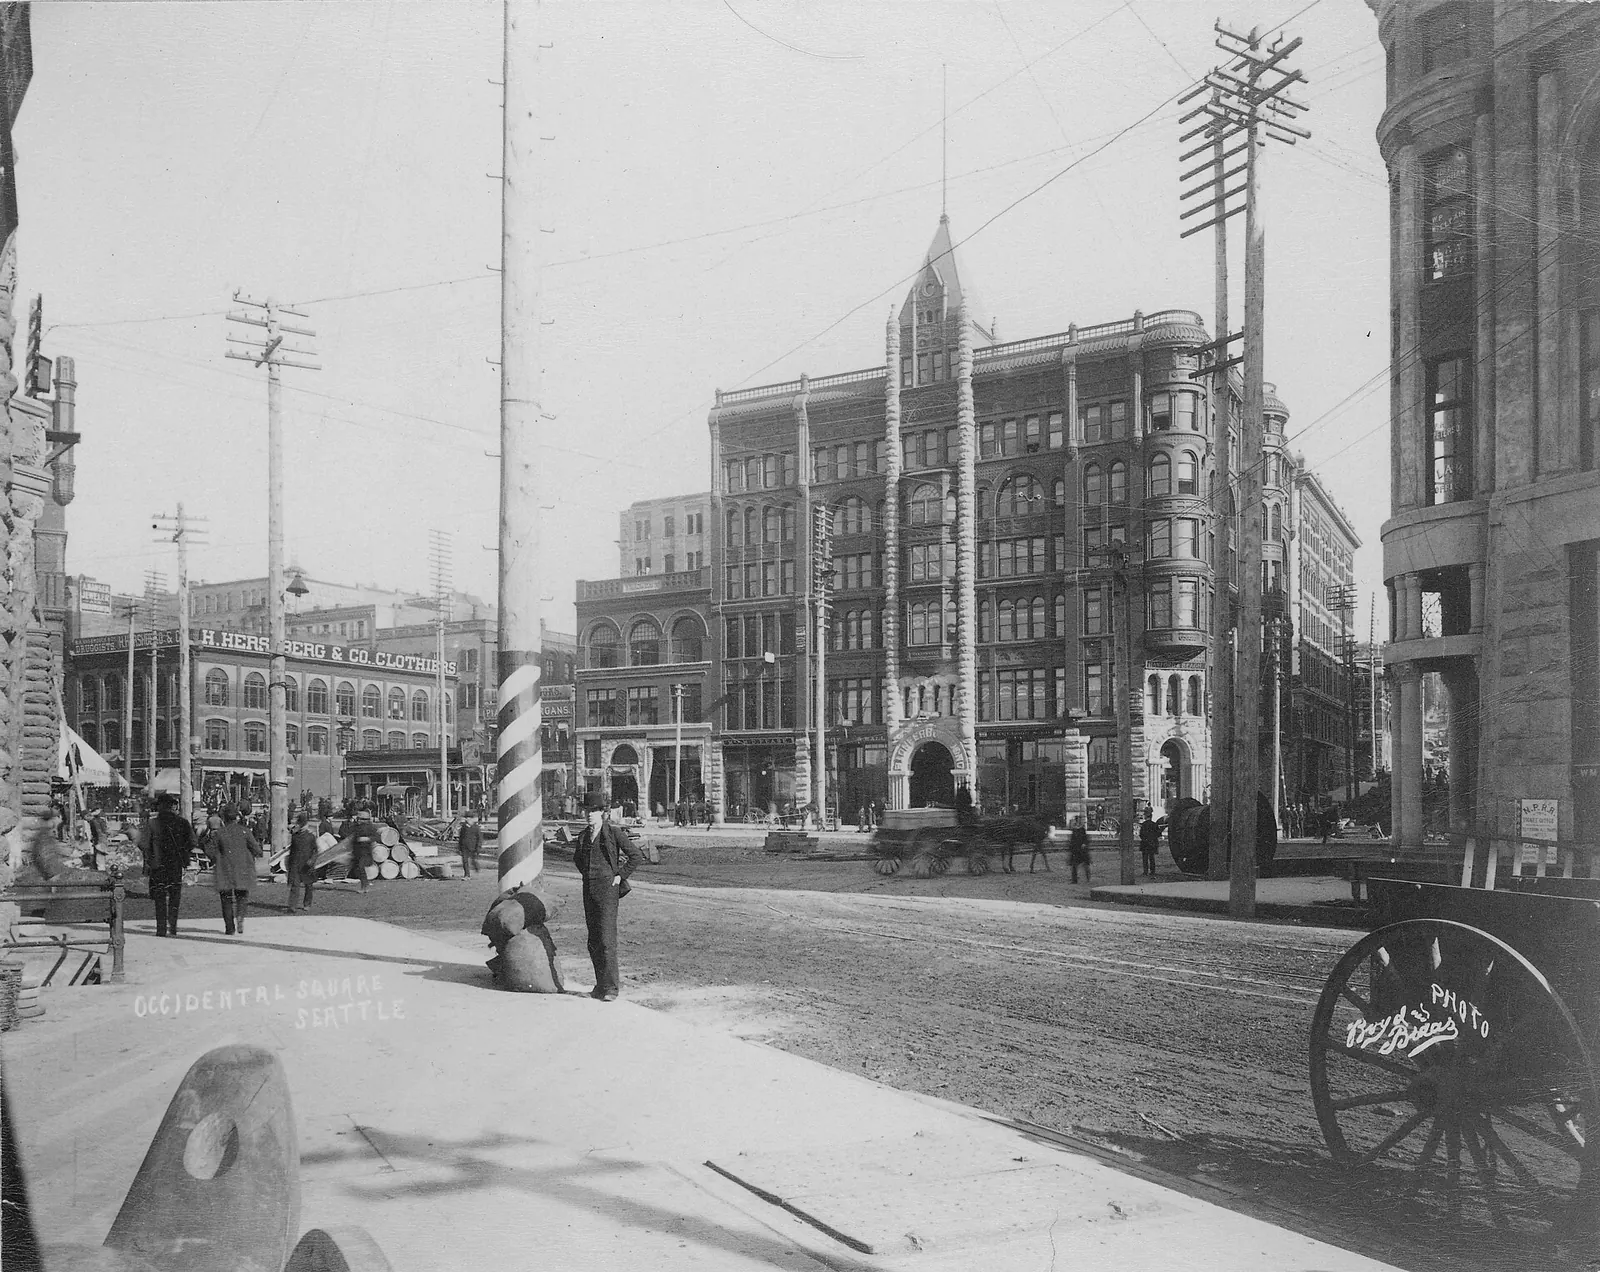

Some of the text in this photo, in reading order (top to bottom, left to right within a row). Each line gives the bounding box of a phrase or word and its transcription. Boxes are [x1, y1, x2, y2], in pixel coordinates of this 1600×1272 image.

[221, 632, 325, 659] HERSBERG
[331, 646, 342, 661] &
[376, 652, 457, 675] CLOTHIERS
